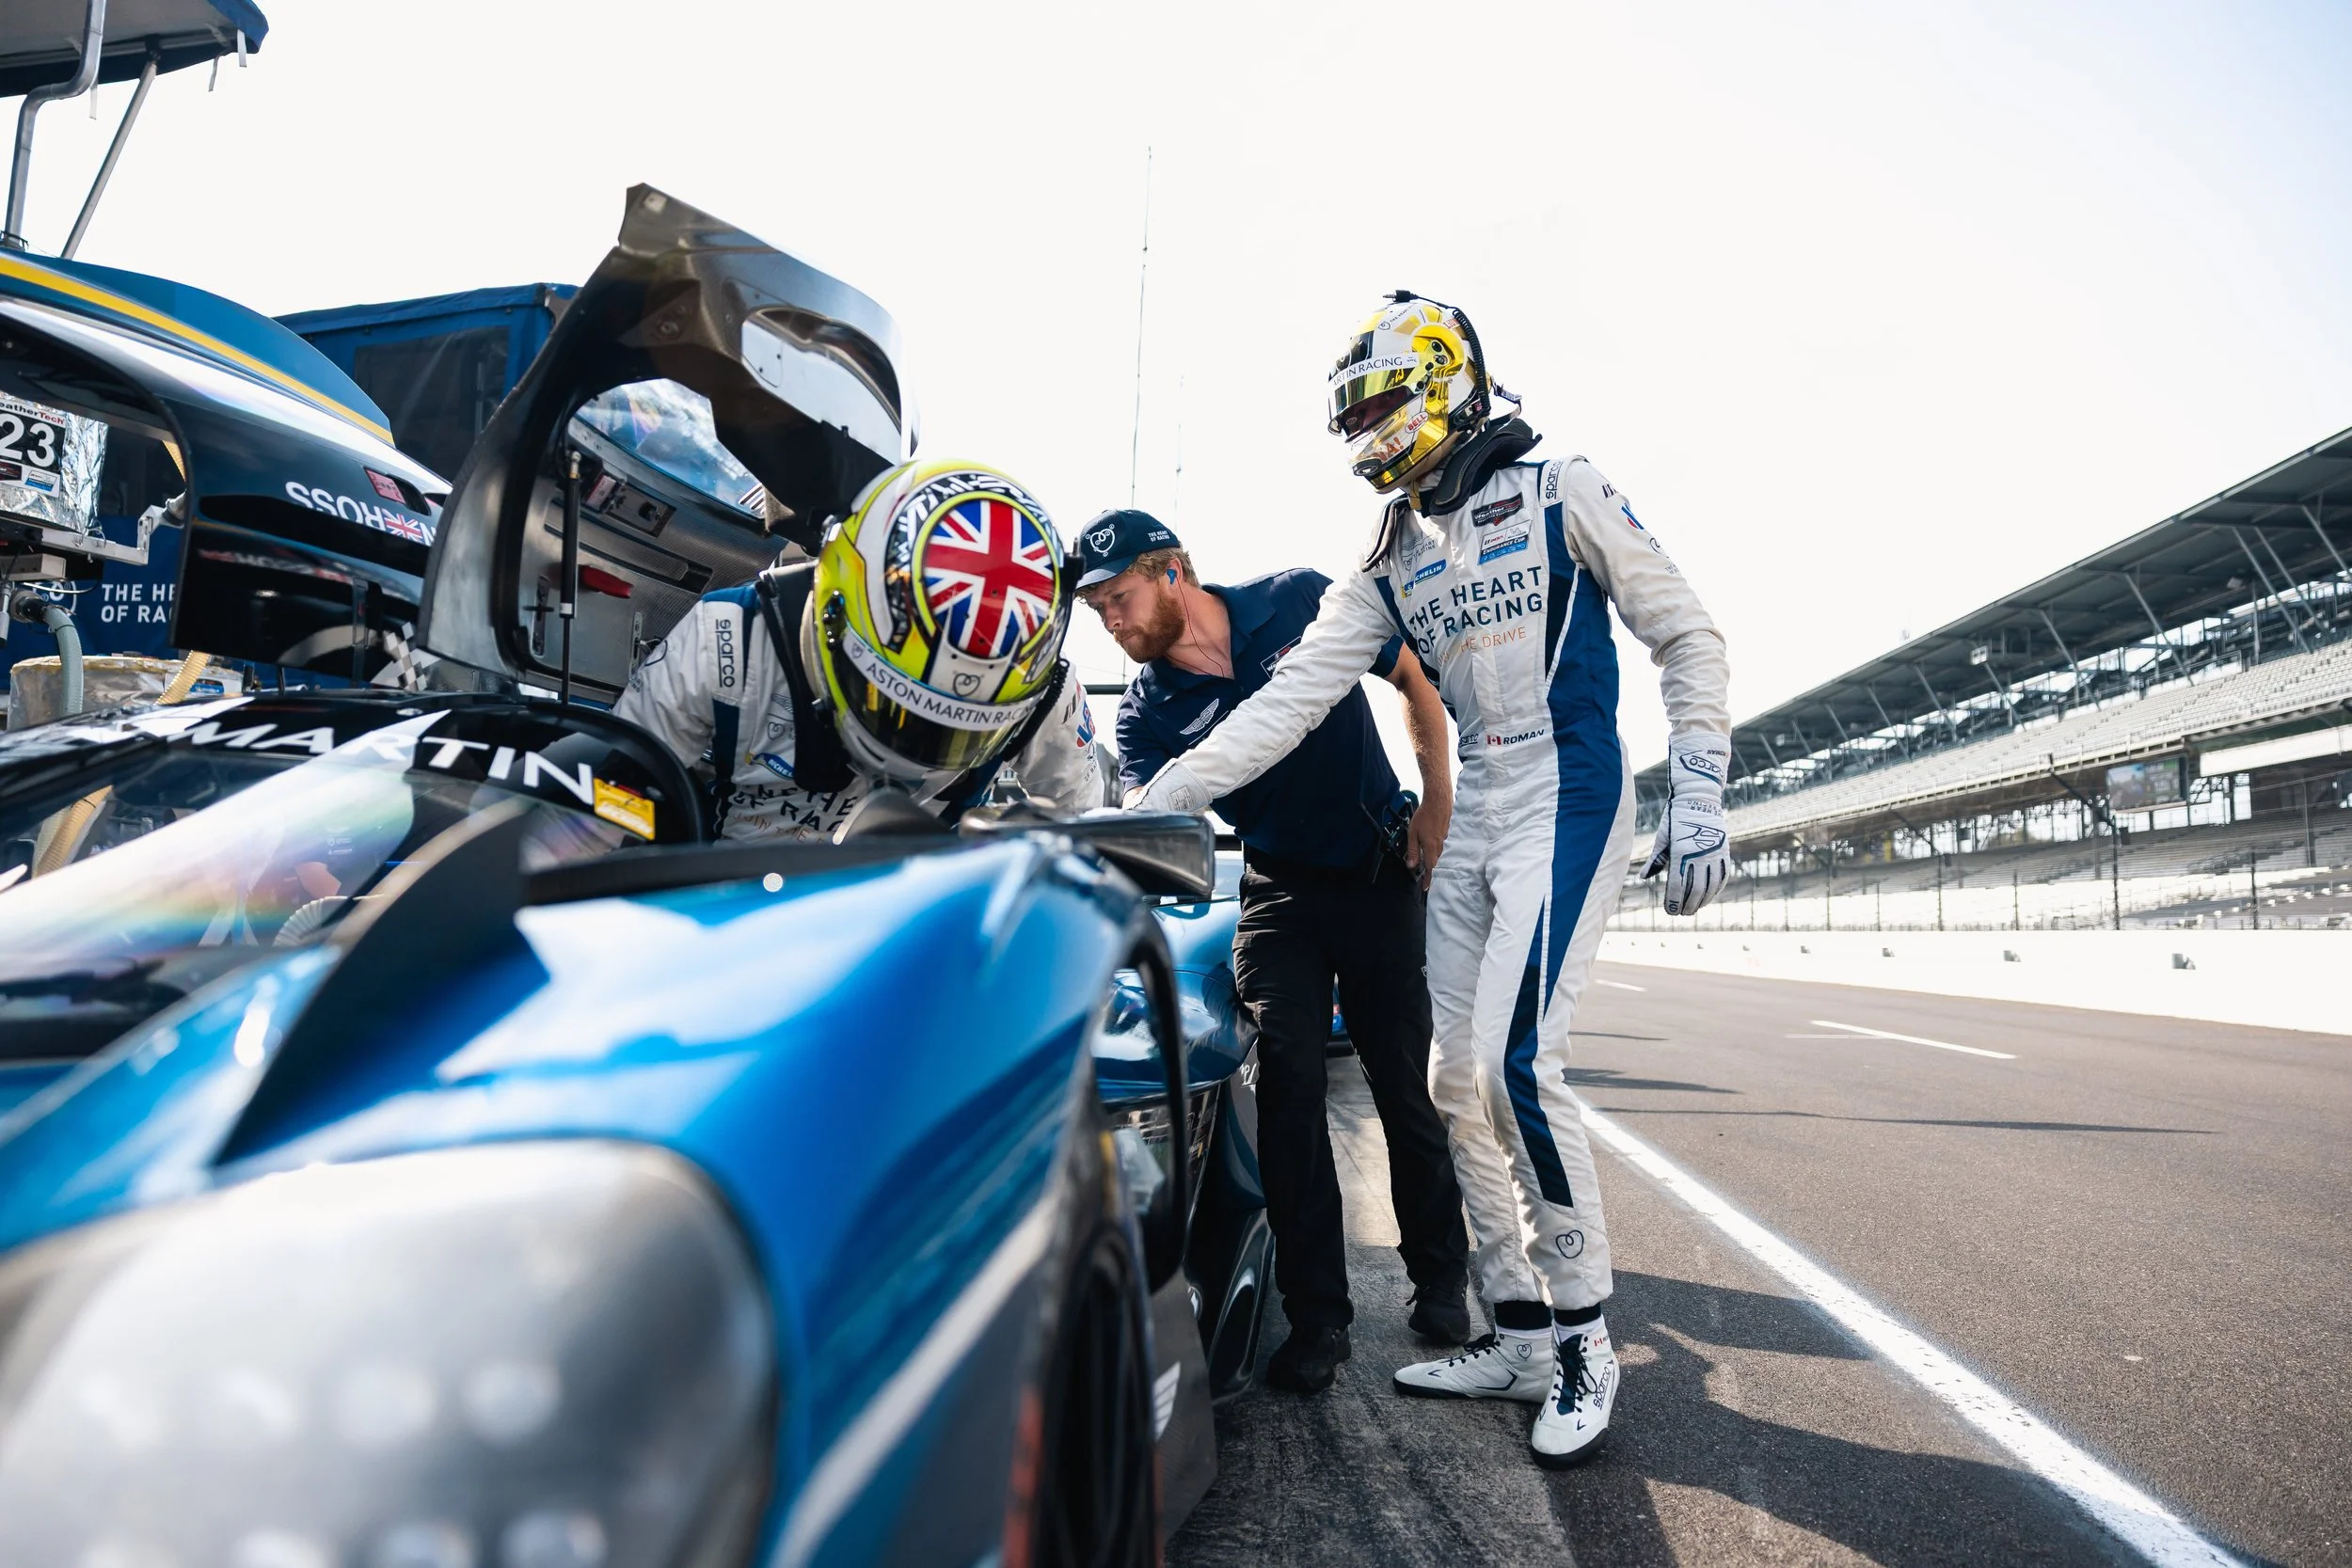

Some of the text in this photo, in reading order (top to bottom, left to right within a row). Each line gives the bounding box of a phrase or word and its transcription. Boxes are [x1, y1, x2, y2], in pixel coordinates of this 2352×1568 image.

[1359, 356, 1403, 373] RACING
[0, 413, 55, 467] 23
[1407, 414, 1426, 431] BELL
[1546, 461, 1564, 499] sparco
[102, 583, 143, 602] THE
[1408, 566, 1541, 631] THE HEART
[101, 605, 128, 623] OF
[1418, 593, 1542, 654] OF RACING
[715, 619, 736, 689] sparco
[1483, 626, 1527, 648] DRIVE
[866, 662, 922, 705] ASTON
[924, 697, 991, 723] MARTIN
[1503, 729, 1545, 745] ROMAN
[167, 721, 594, 807] MARTIN
[1690, 804, 1712, 814] HEAR
[1594, 1366, 1611, 1410] sparco
